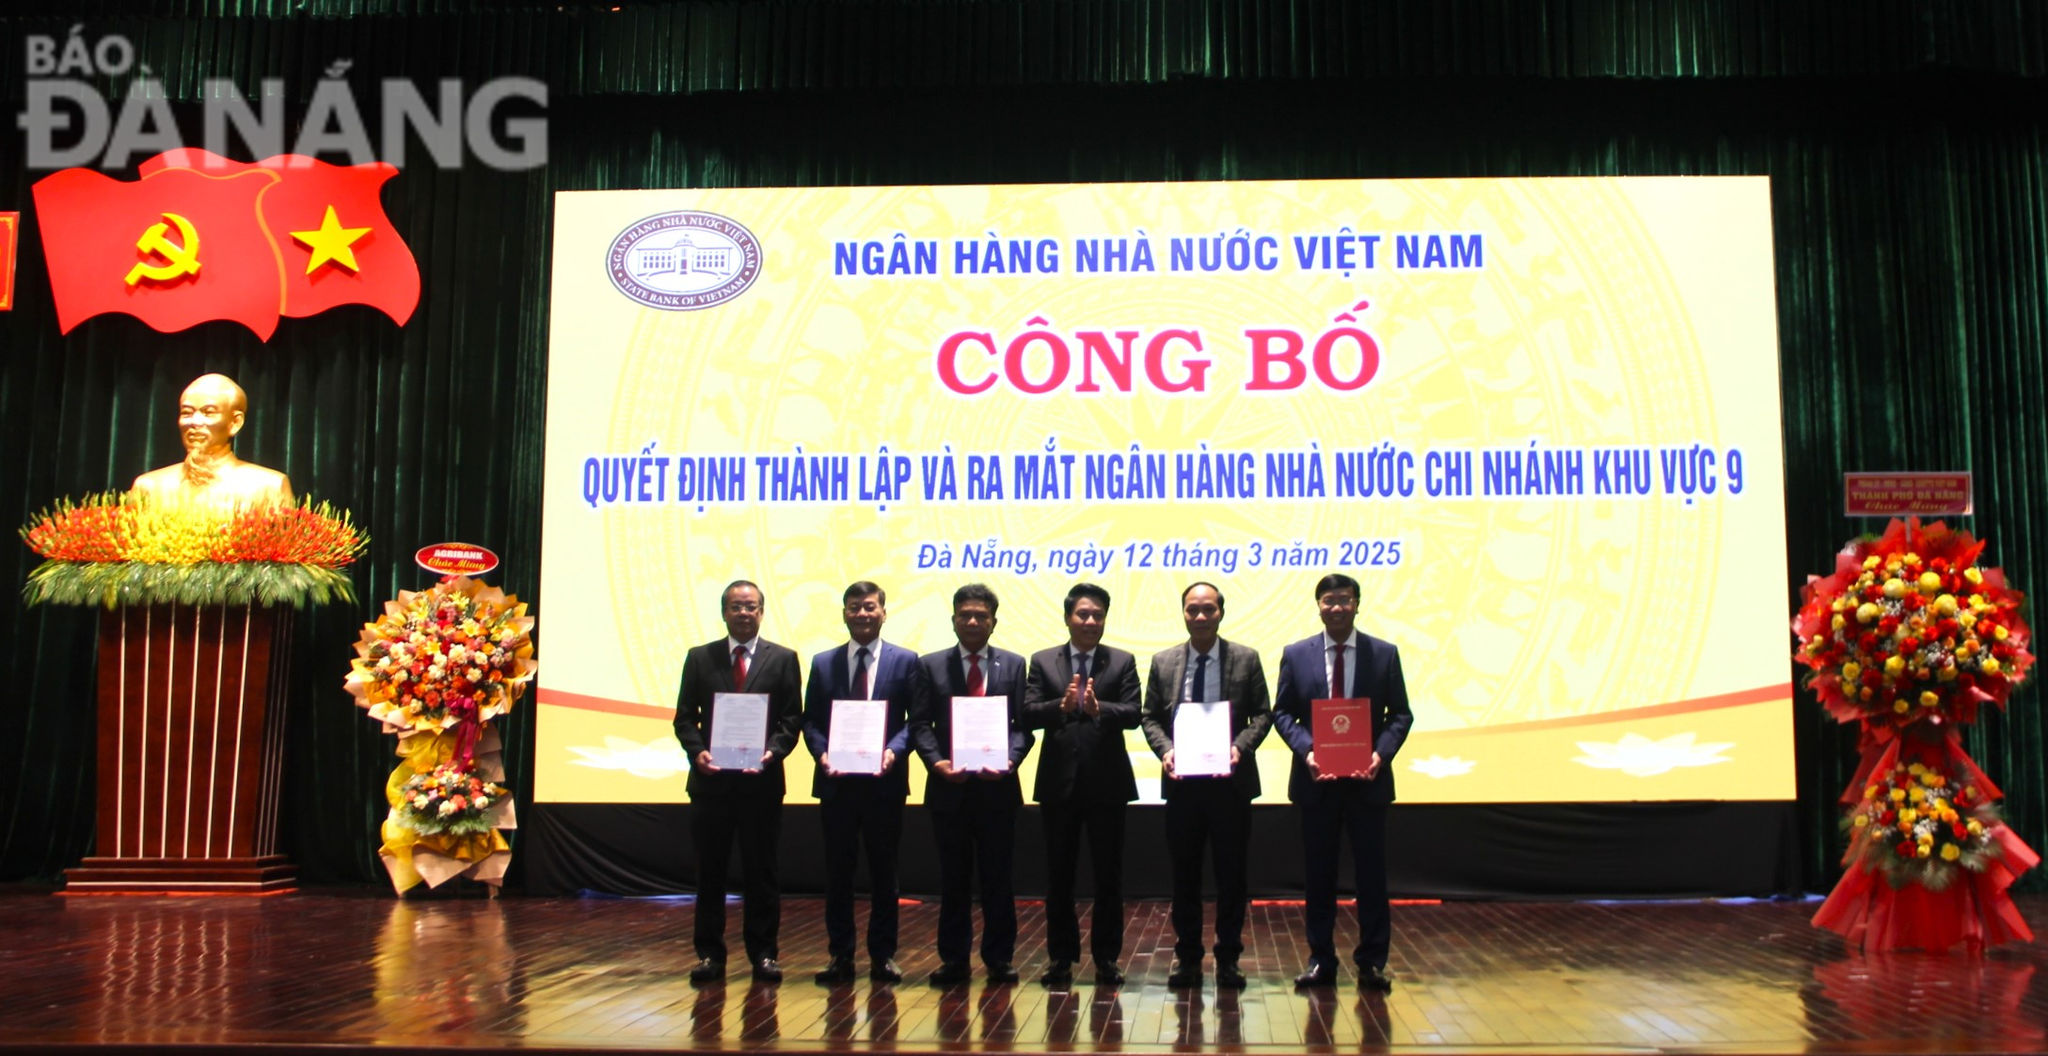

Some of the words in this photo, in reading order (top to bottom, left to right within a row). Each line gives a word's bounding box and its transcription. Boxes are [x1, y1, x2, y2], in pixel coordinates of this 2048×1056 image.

[613, 239, 630, 270] NGÂN
[628, 220, 661, 242] HÀNG
[662, 214, 688, 226] NHÀ
[689, 215, 723, 230] NƯỚC
[724, 223, 748, 247] VIỆT
[743, 242, 755, 269] NAM
[834, 232, 938, 276] NGÂN
[954, 231, 1059, 275] HÀNG
[1075, 230, 1155, 273] NHÀ
[1170, 229, 1279, 272] NƯỚC
[1293, 226, 1381, 278] VIỆT
[1396, 234, 1483, 269] NAM
[620, 277, 648, 300] STATE
[649, 293, 680, 306] BANK
[681, 296, 697, 305] OF
[698, 276, 747, 303] VIETNAM
[936, 315, 1212, 395] CÔNG
[1244, 300, 1380, 391] BỐ
[583, 441, 670, 509] QUYẾT
[677, 456, 746, 513] ĐỊNH
[755, 446, 849, 502] THÀNH
[858, 445, 912, 512] LẬP
[921, 445, 958, 501] VÀ
[967, 455, 1004, 501] RA
[1014, 436, 1076, 500] MẮT
[1085, 443, 1166, 501] NGÂN
[1175, 443, 1255, 499] HÀNG
[1265, 442, 1326, 498] NHÀ
[1335, 441, 1415, 498] NƯỚC
[1425, 450, 1473, 498] CHI
[1482, 439, 1584, 496] NHÁNH
[1593, 449, 1651, 496] KHU
[1660, 443, 1717, 505] VỰC
[1726, 448, 1743, 495] 9
[434, 549, 484, 559] AGRIBANK
[917, 543, 953, 569] Đà
[961, 539, 1038, 575] Nẵng,
[1048, 542, 1115, 575] ngày
[1124, 543, 1154, 568] 12
[1162, 542, 1239, 574] tháng
[1248, 541, 1263, 567] 3
[1271, 542, 1329, 566] năm
[1339, 541, 1401, 566] 2025
